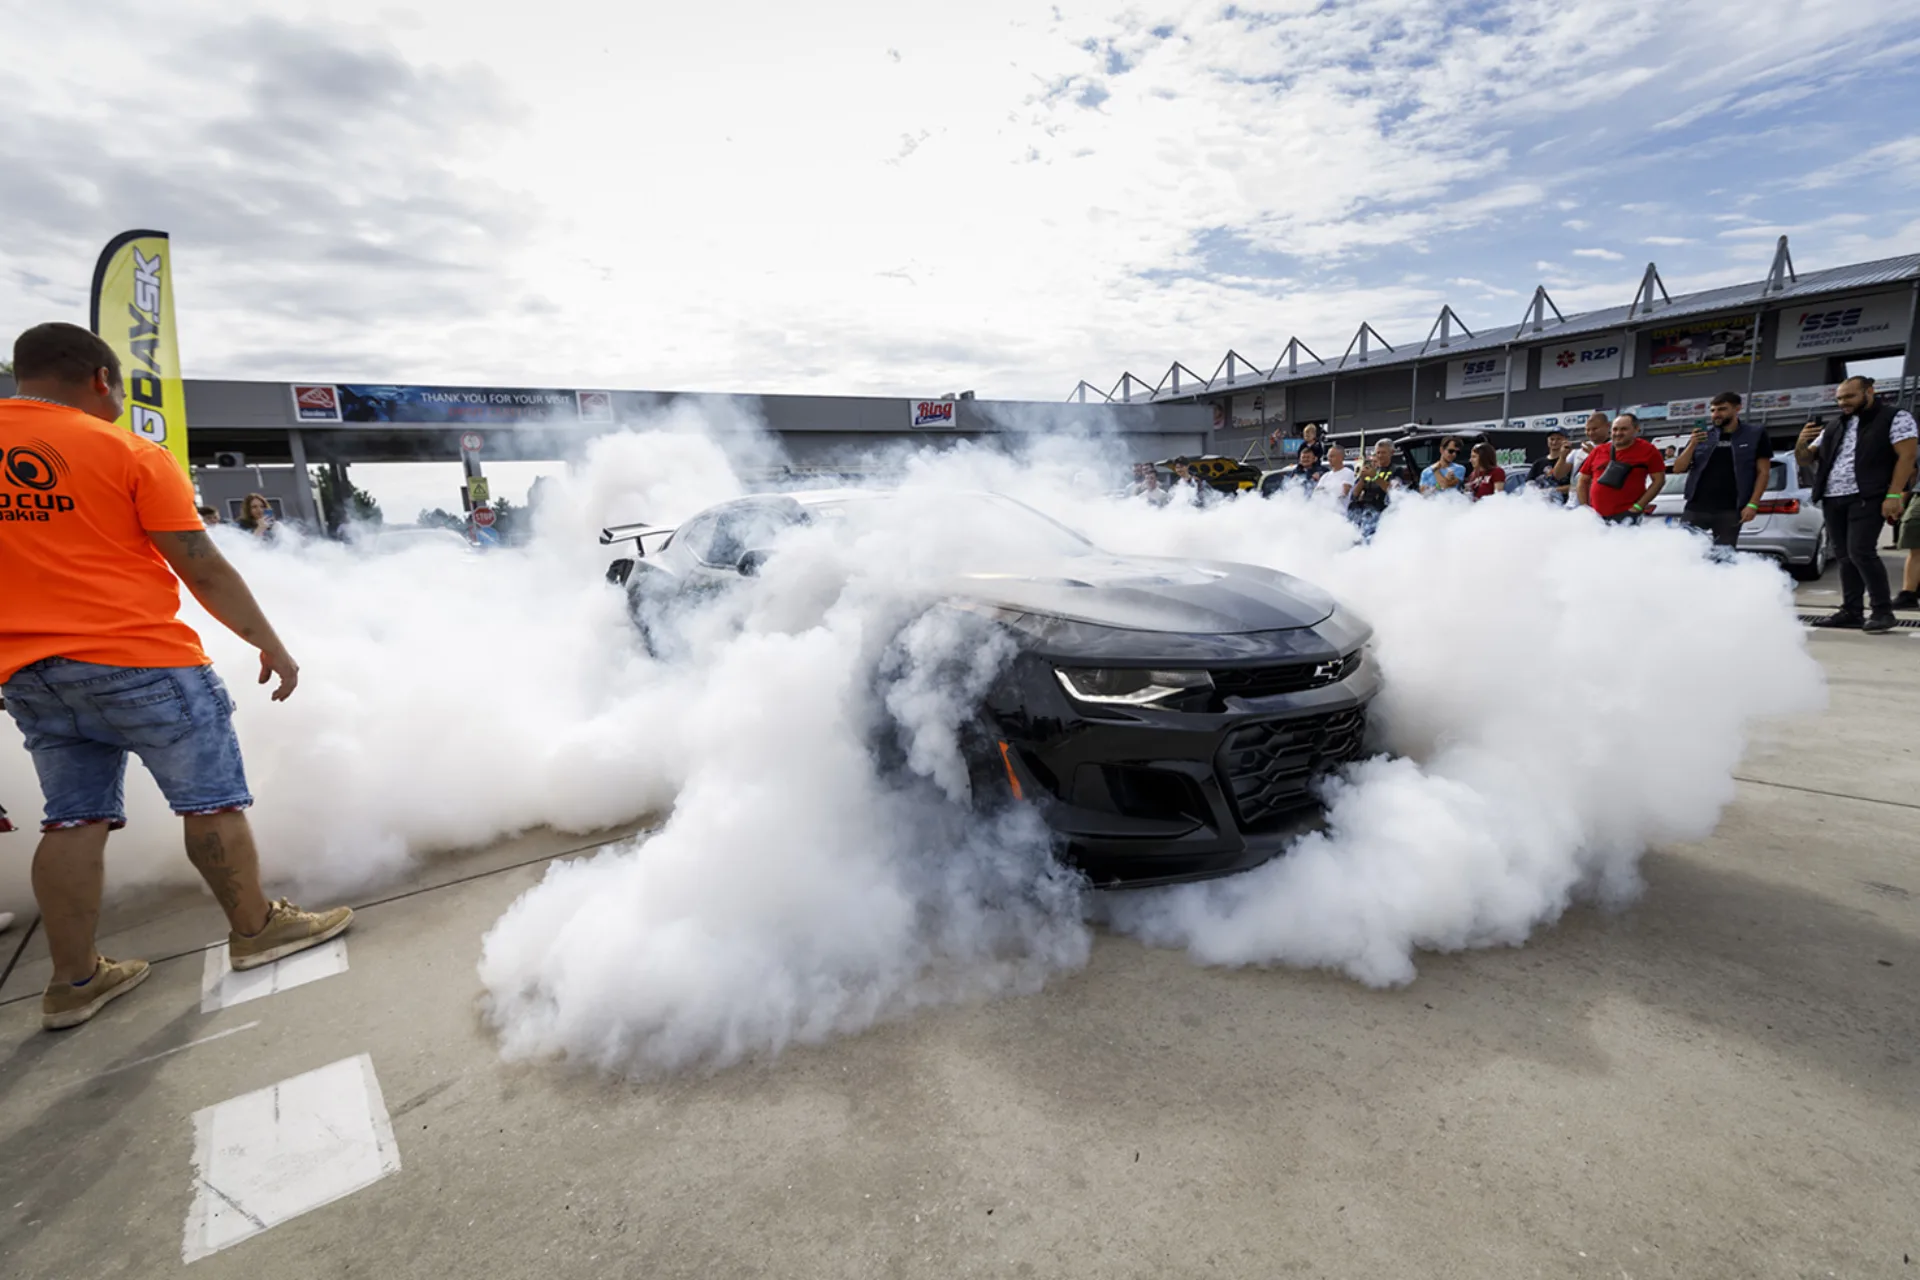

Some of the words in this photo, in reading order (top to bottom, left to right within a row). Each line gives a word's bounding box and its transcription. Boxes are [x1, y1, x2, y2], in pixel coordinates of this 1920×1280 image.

[129, 246, 168, 449] GDAY.SK
[1580, 346, 1619, 362] RZP
[420, 392, 460, 403] THANK
[462, 393, 487, 404] YOU
[489, 393, 512, 404] FOR
[513, 394, 544, 404] YOUR
[545, 395, 570, 405] VISIT
[917, 402, 952, 418] Ring
[475, 512, 493, 521] STOP
